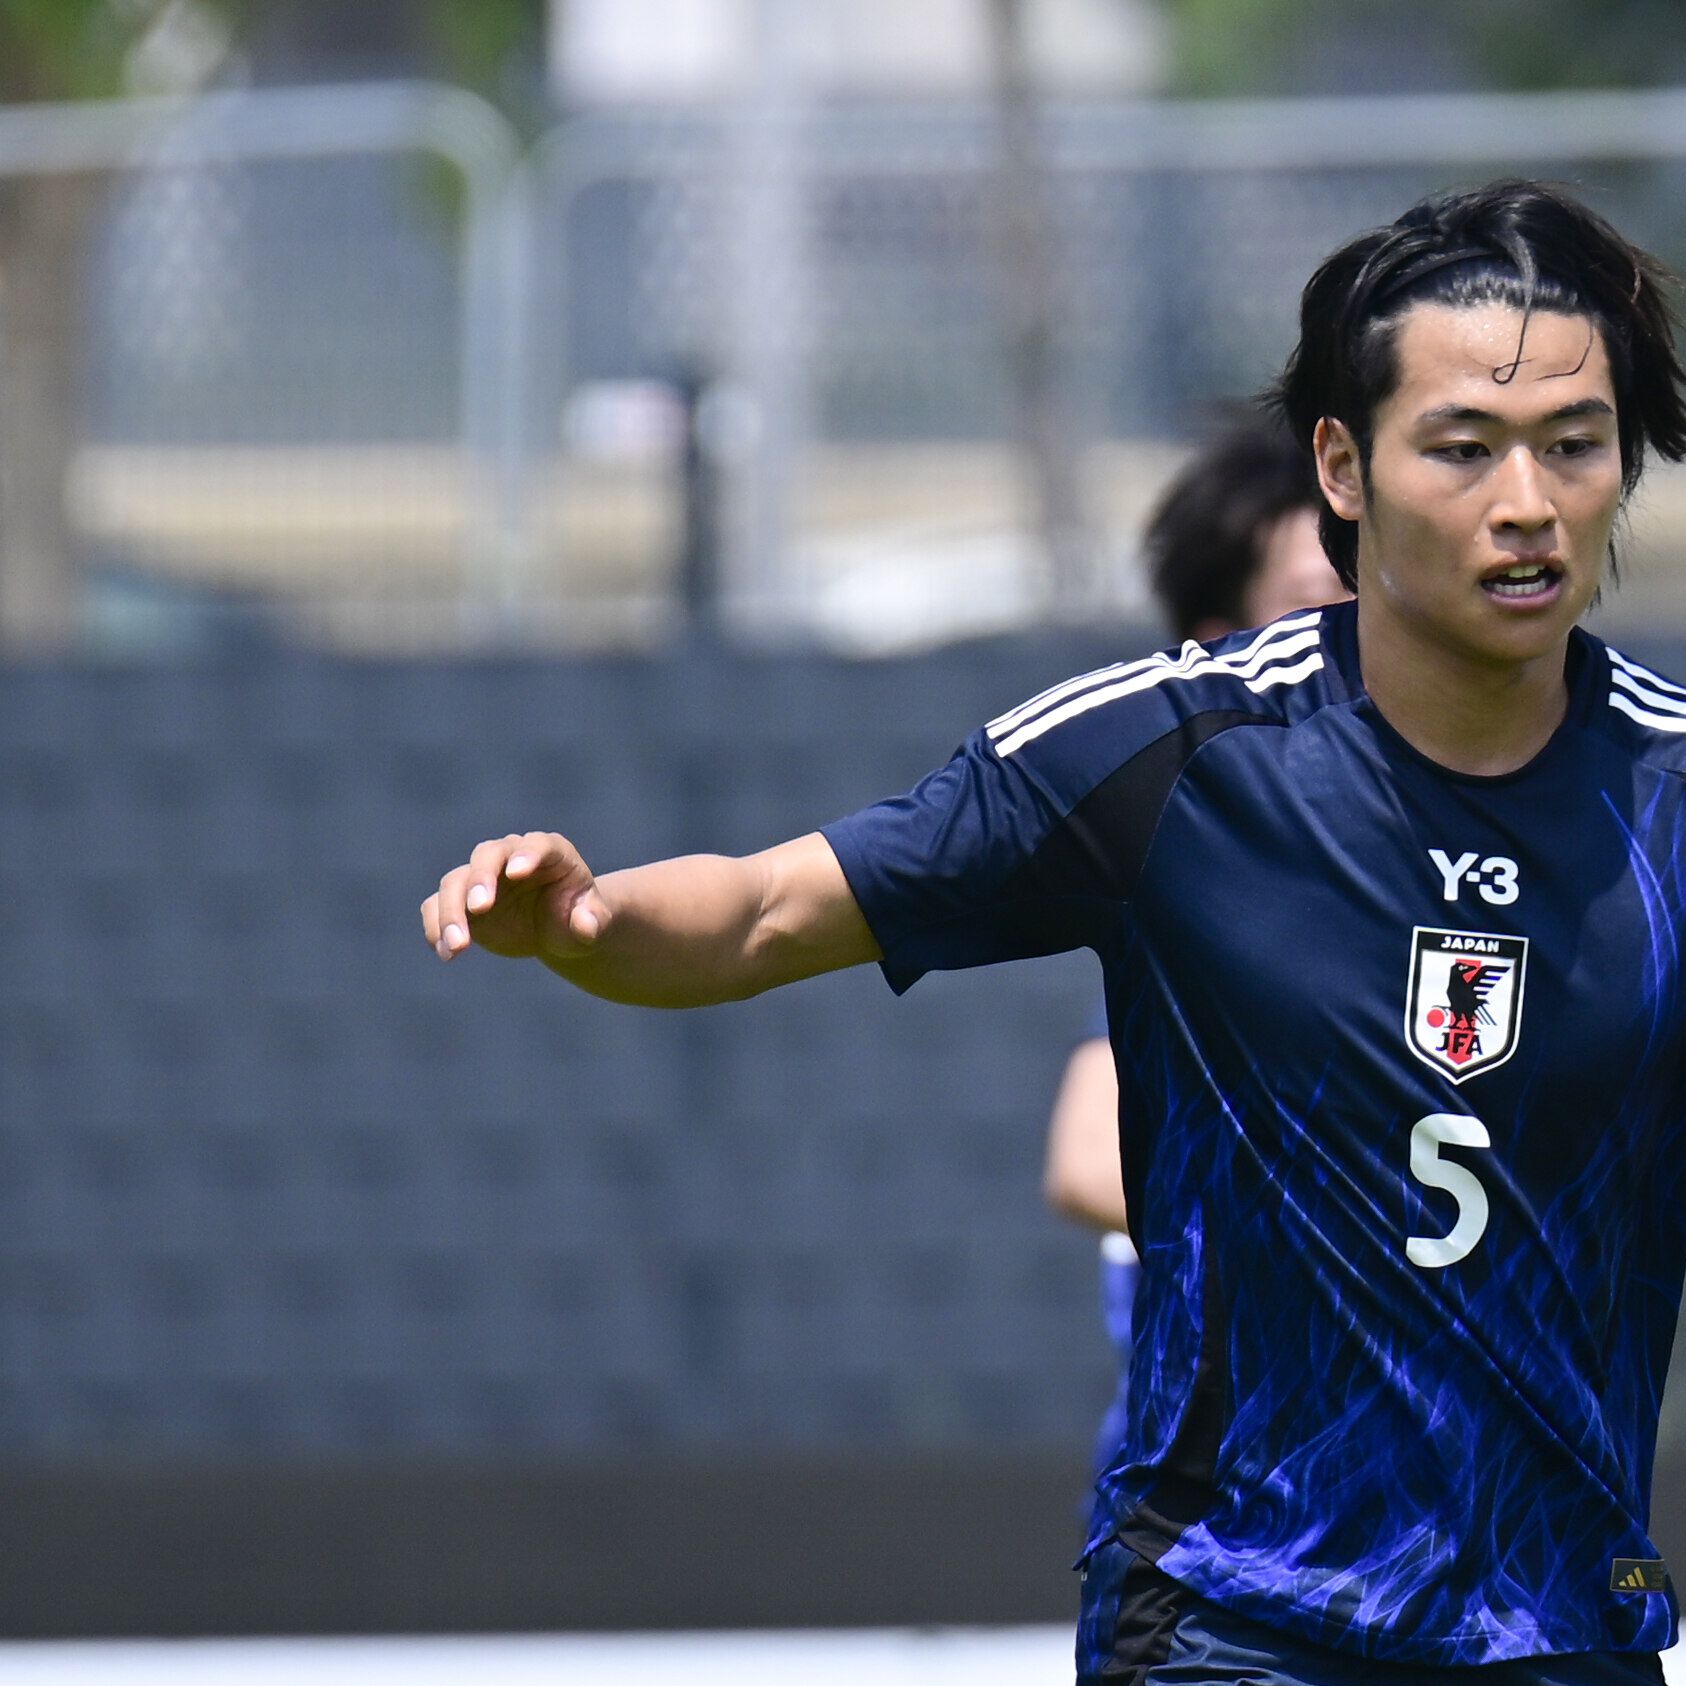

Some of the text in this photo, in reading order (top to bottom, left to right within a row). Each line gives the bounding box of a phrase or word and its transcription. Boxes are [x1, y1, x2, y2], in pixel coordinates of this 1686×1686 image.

[1428, 848, 1520, 905] Y-3
[1440, 936, 1500, 953] JAPAN
[1435, 1031, 1483, 1056] JFA
[1405, 1112, 1491, 1268] 5
